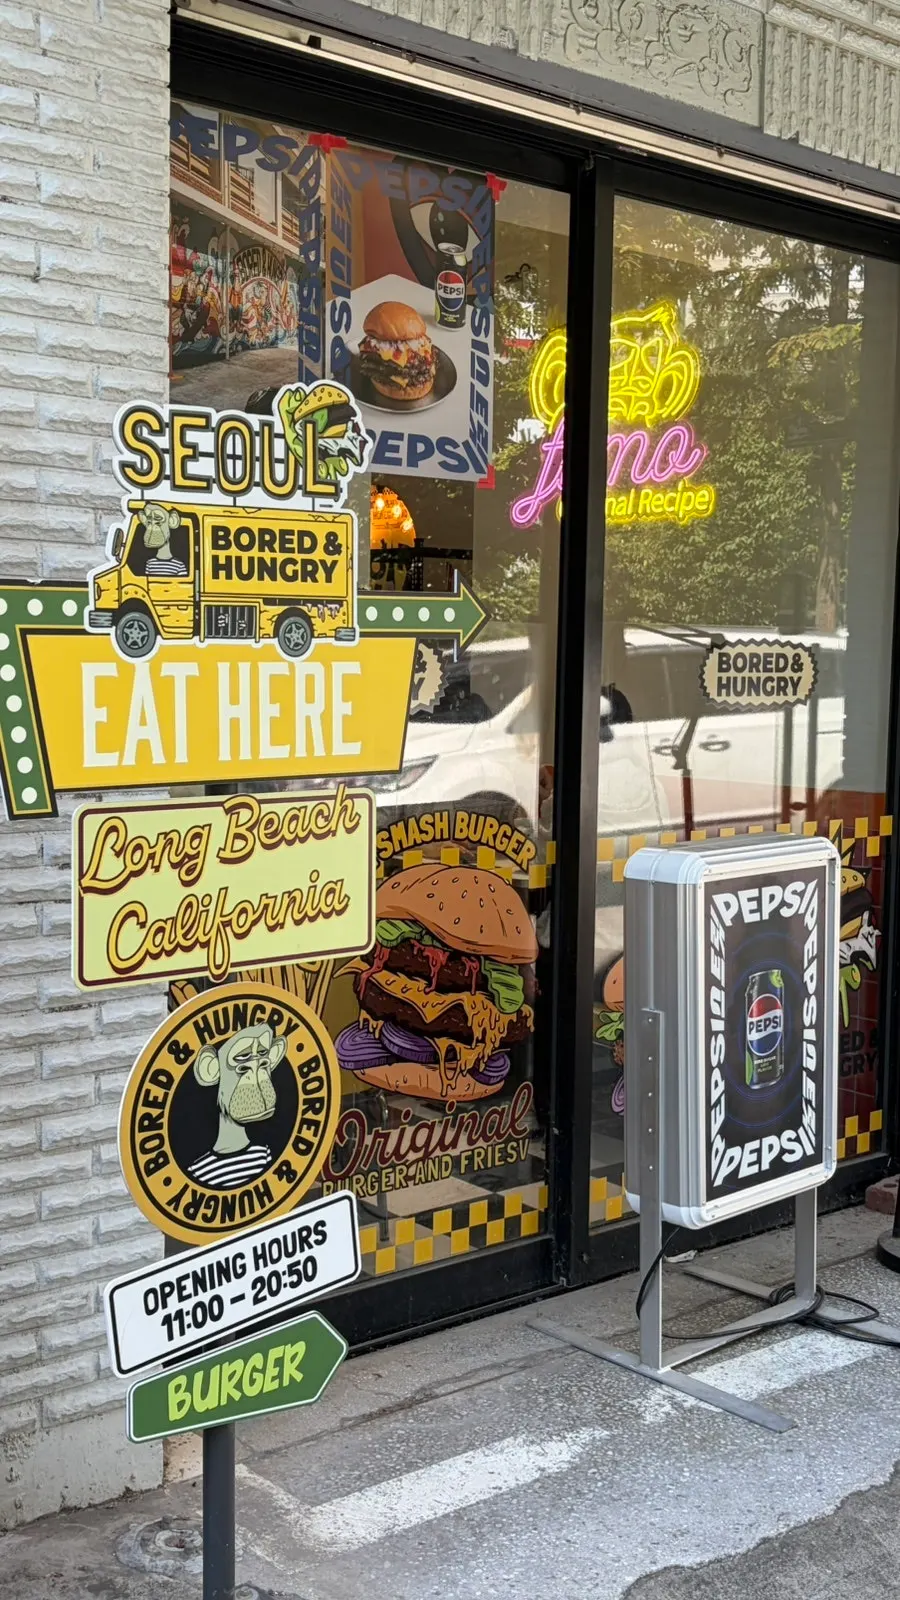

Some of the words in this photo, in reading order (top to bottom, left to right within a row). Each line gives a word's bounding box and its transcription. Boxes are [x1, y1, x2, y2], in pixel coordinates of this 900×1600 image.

[335, 151, 490, 215] PEPSI
[438, 283, 464, 296] PEPSI
[118, 405, 341, 500] SEOUL
[637, 479, 710, 518] Recipe
[211, 526, 318, 555] BORED
[323, 531, 343, 556] &
[211, 555, 339, 584] HUNGRY
[716, 676, 802, 697] HUNGRY
[717, 652, 789, 673] BORED
[790, 652, 804, 673] &
[81, 662, 199, 768] EAT
[217, 661, 362, 761] HERE
[79, 816, 212, 896] Long
[216, 783, 361, 864] Beach
[376, 810, 450, 860] SMASH
[453, 810, 537, 873] BURGER
[106, 869, 351, 982] California
[712, 879, 818, 927] PEPSI
[748, 1015, 782, 1035] PEPSI
[138, 1068, 175, 1178] BORED
[167, 1039, 195, 1065] &
[193, 1002, 300, 1045] HUNGRY
[293, 1055, 325, 1156] BORED
[322, 1081, 534, 1181] Original
[713, 1126, 816, 1188] PEPSI
[272, 1159, 298, 1185] &
[414, 1153, 453, 1185] AND
[166, 1180, 275, 1224] HUNGRY
[143, 1252, 247, 1316] OPENING
[252, 1219, 328, 1271] HOURS
[161, 1294, 224, 1342] 11:00
[251, 1255, 318, 1306] 20:50
[167, 1340, 307, 1422] BURGER
